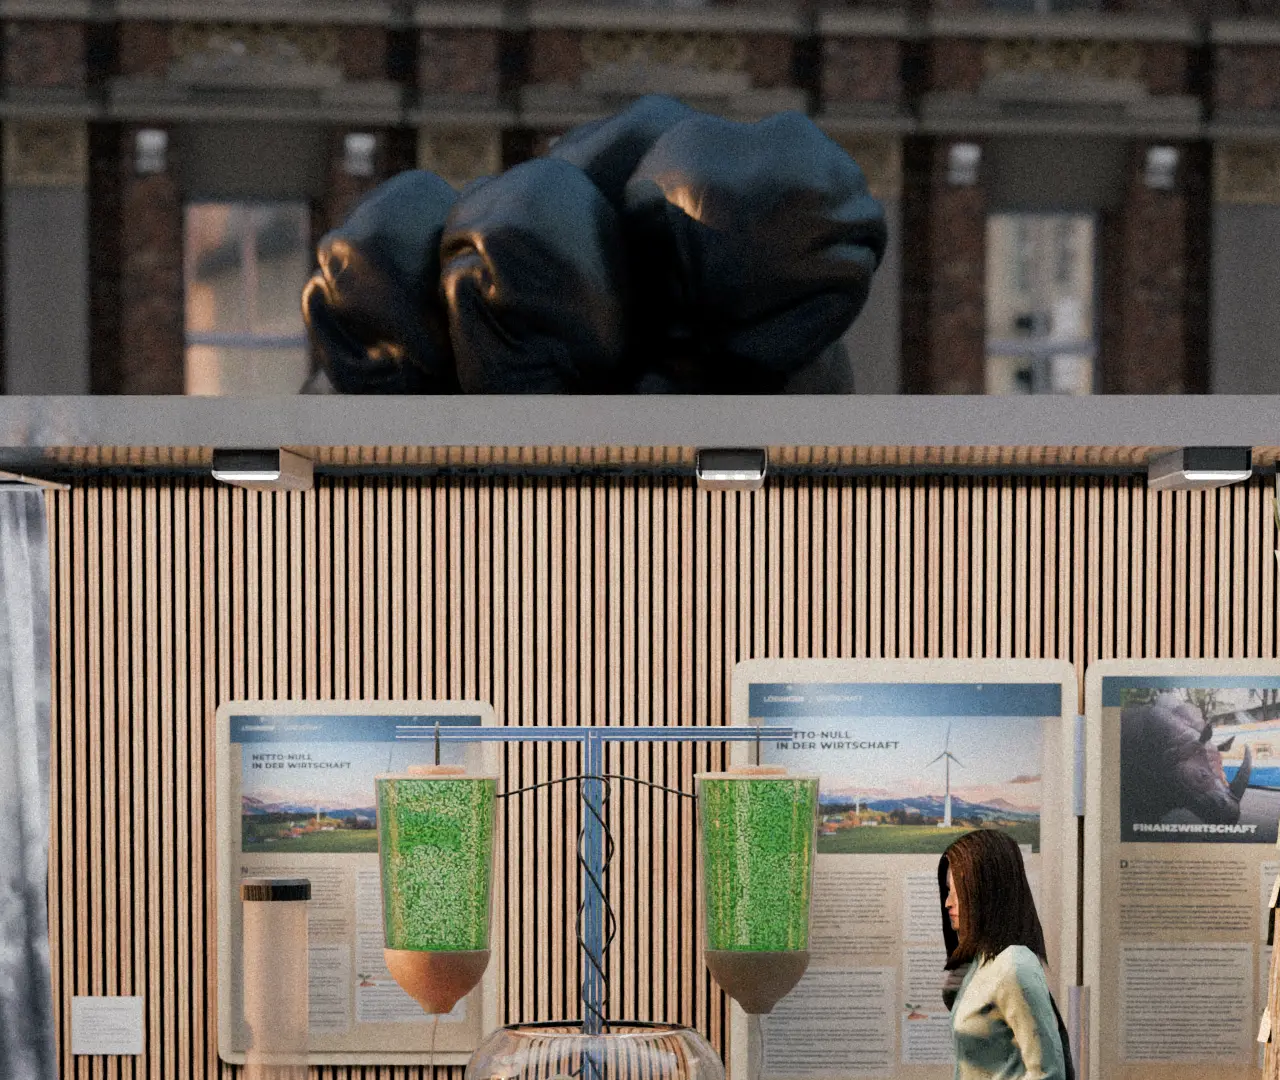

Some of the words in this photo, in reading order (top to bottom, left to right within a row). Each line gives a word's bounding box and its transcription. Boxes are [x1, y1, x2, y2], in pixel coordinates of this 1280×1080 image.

[793, 731, 852, 739] TTO-NULL
[821, 741, 900, 749] WIRTSCHAFT
[1133, 823, 1258, 834] FINANZWIRTSCHAFT
